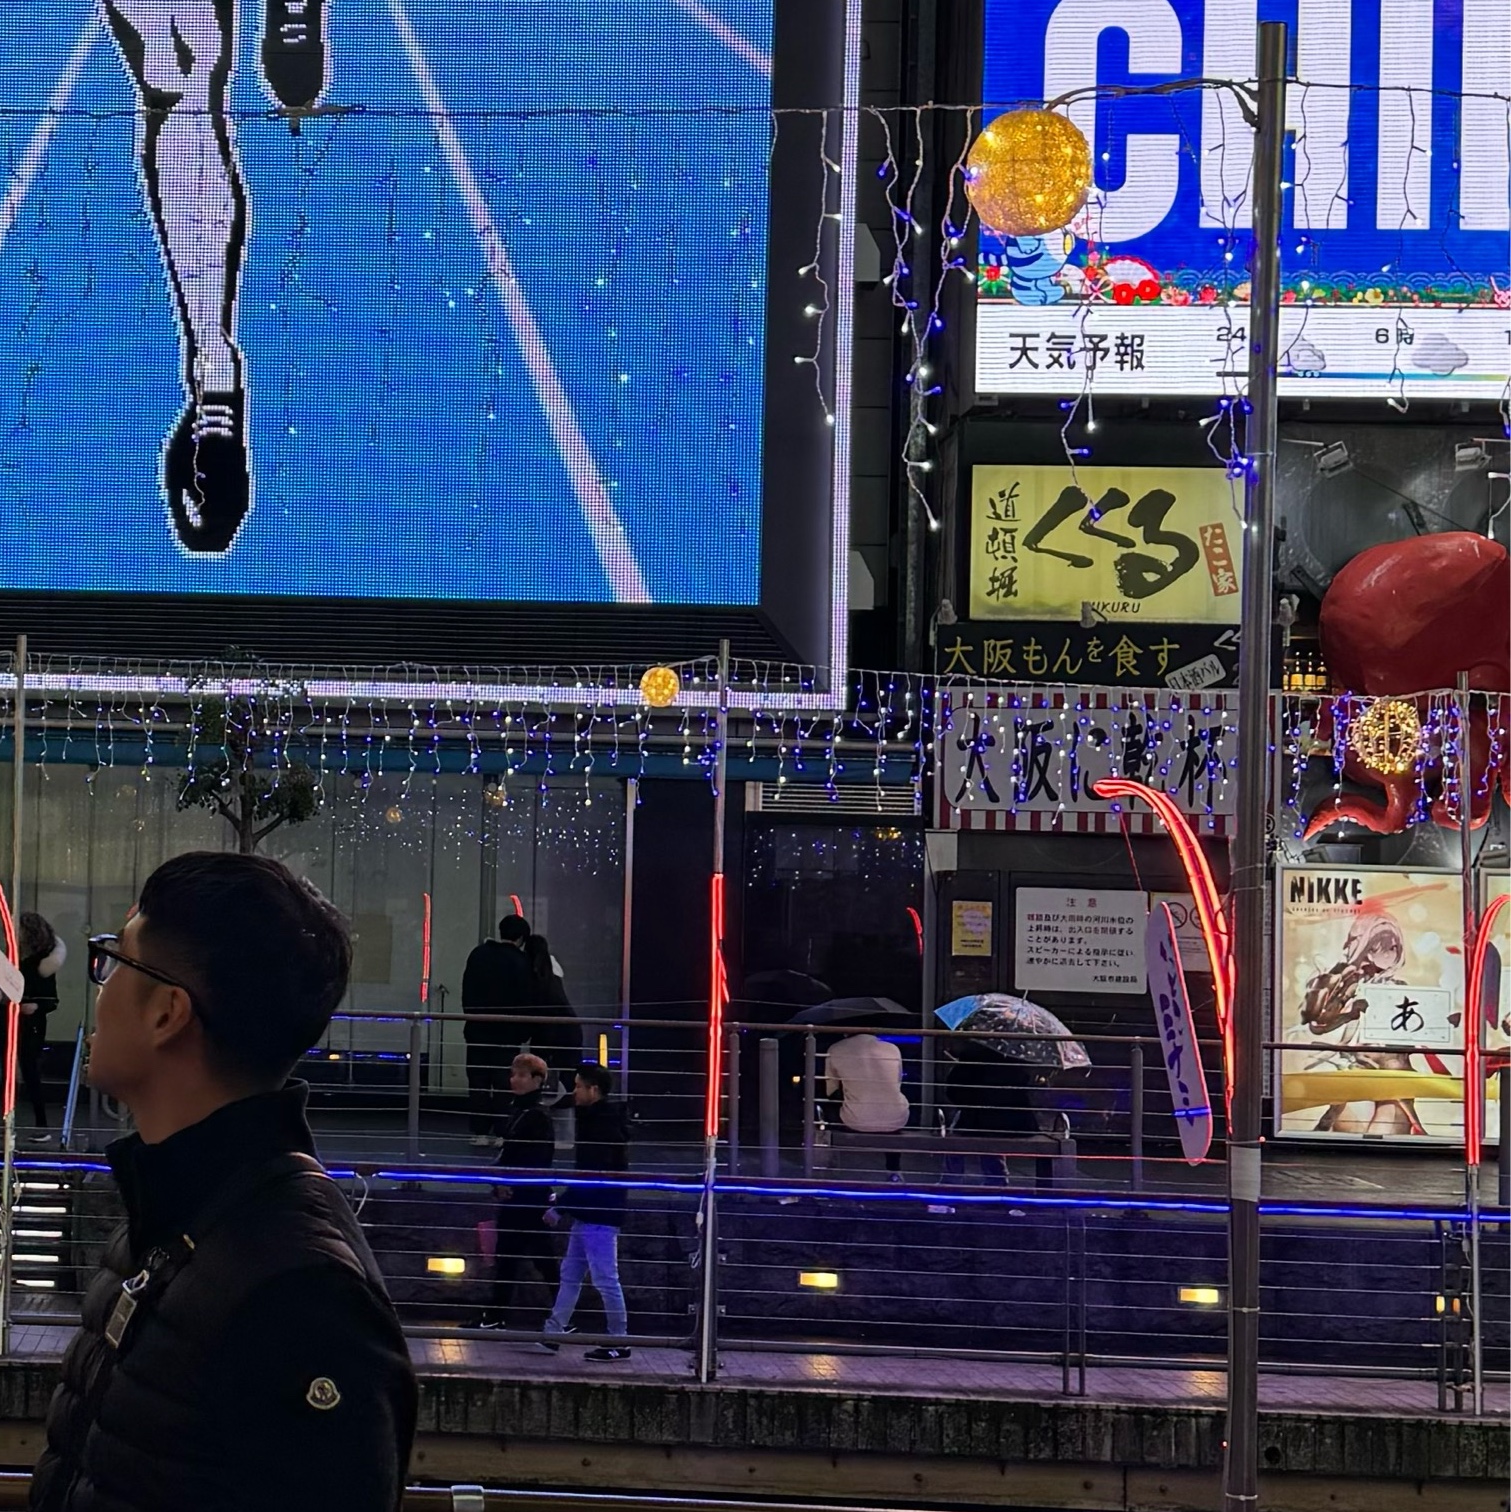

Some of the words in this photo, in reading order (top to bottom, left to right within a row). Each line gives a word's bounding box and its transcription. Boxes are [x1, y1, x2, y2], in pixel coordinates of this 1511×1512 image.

[1009, 332, 1145, 371] 天気予報
[985, 481, 1022, 602] 道頓堀
[1022, 484, 1199, 600] くくる
[1201, 525, 1238, 596] たこ家
[944, 634, 1180, 678] 大阪もんを食す
[955, 711, 1226, 812] 大阪に乾杯
[1290, 876, 1363, 905] NIKKE
[1391, 995, 1424, 1032] あ
